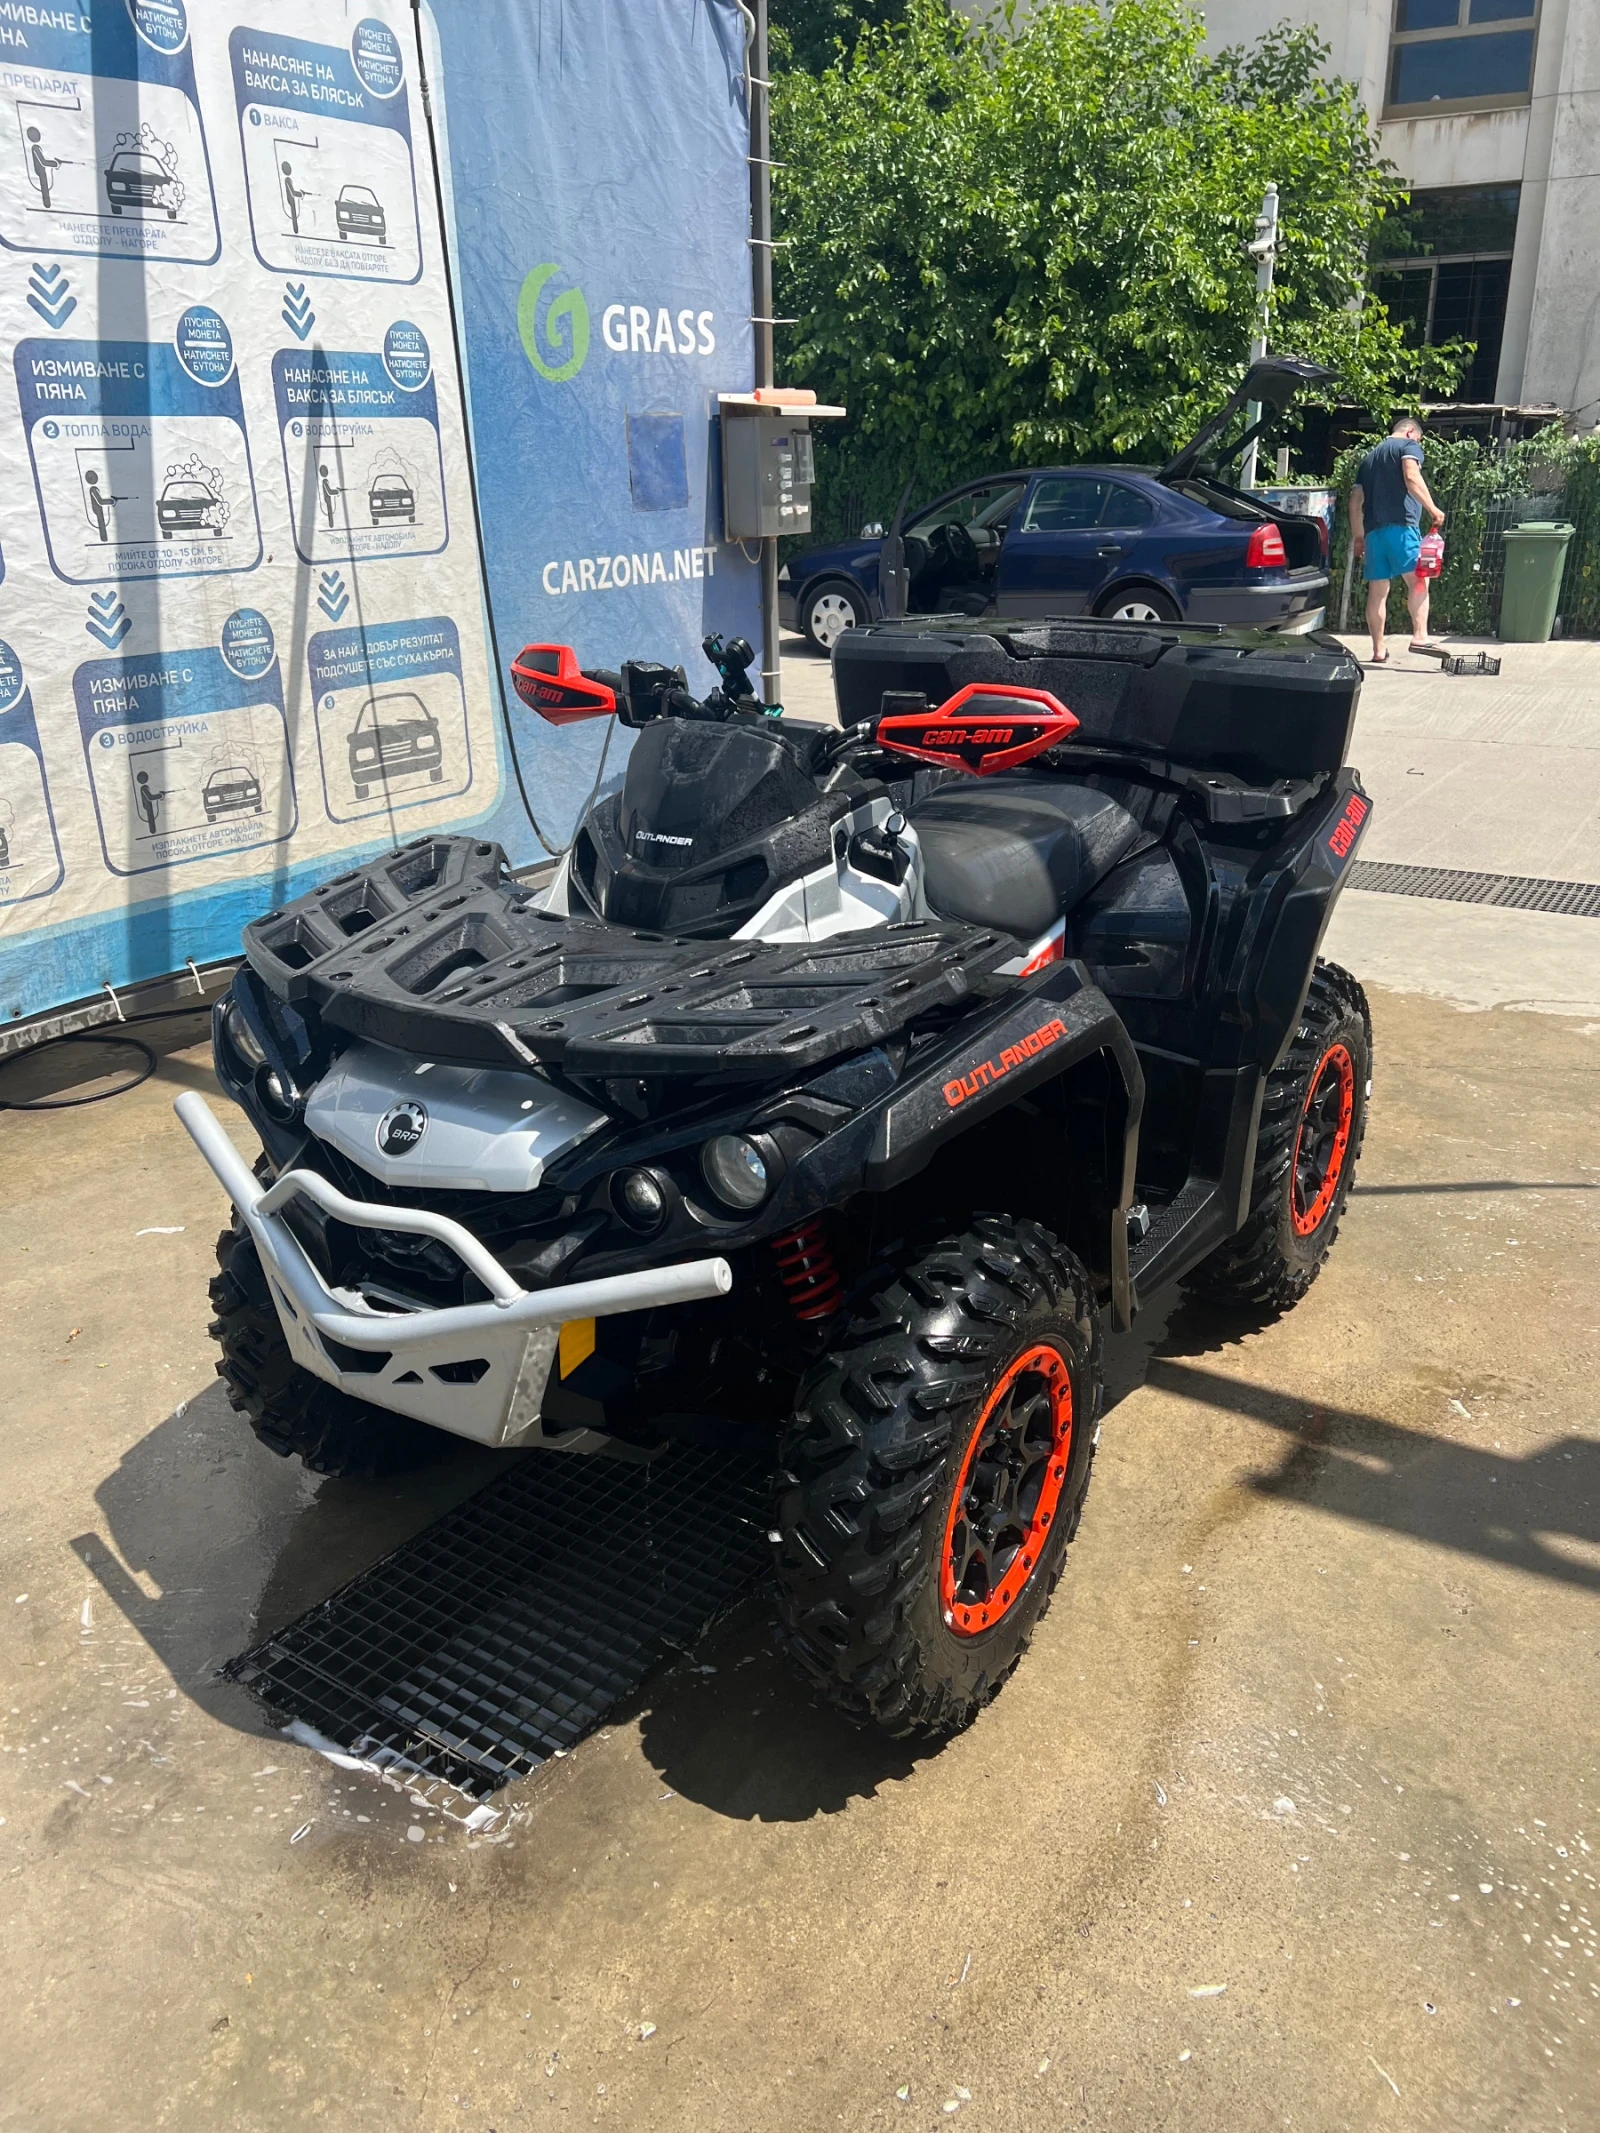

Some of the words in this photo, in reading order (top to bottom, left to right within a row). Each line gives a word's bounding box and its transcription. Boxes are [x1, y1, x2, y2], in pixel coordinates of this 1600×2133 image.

[136, 8, 184, 30] НАТИСНЕТЕ
[145, 23, 179, 40] БУТОНА
[358, 27, 392, 44] ПУСНЕТЕ
[361, 39, 392, 54] МОНЕТА
[242, 47, 313, 77] НАНАСЯНЕ
[316, 63, 335, 82] НА
[357, 58, 400, 76] НАТИСНЕТЕ
[3, 72, 78, 95] ПРЕПАРАТ
[365, 71, 394, 85] БУТОНА
[245, 70, 290, 94] ВАКСА
[292, 79, 310, 98] ЗА
[311, 83, 364, 108] БЛЯСЪК
[263, 113, 300, 131] ВАКСА
[59, 222, 111, 236] НАНЕСЕТЕ
[112, 225, 168, 240] ПРЕПАРАТА
[121, 238, 158, 249] НАГОРЕ
[184, 317, 221, 329] ПУСНЕТЕ
[602, 304, 716, 356] GRASS
[188, 329, 222, 340] МОНЕТА
[390, 330, 420, 341] ПУСНЕТЕ
[392, 340, 420, 350] МОНЕТА
[183, 350, 230, 361] НАТИСНЕТЕ
[388, 359, 428, 369] НАТИСНЕТЕ
[31, 359, 131, 378] ИЗМИВАНЕ
[133, 362, 145, 379] С
[193, 361, 226, 372] БУТОНА
[395, 369, 423, 379] БУТОНА
[284, 368, 351, 384] НАНАСЯНЕ
[352, 369, 370, 385] НА
[35, 382, 87, 400] ПЯНА
[286, 388, 328, 403] ВАКСА
[328, 389, 346, 404] ЗА
[347, 389, 396, 404] БЛЯСЪК
[62, 424, 110, 437] ТОПЛА
[305, 422, 374, 437] ВОДОСТРУЙКА
[115, 549, 147, 560] МИЙТЕ
[148, 550, 160, 559] ОТ
[161, 549, 172, 558] 10
[179, 548, 190, 557] 15
[108, 560, 145, 572] ПОСОКА
[147, 558, 183, 569] ОТДОЛУ
[189, 555, 223, 566] НАГОРЕ
[542, 547, 718, 596] CARZONA.NET
[229, 617, 263, 629] ПУСНЕТЕ
[232, 628, 263, 639] МОНЕТА
[228, 645, 272, 659] НАТИСНЕТЕ
[323, 649, 336, 660] ЗА
[338, 642, 359, 658] НАЙ
[366, 641, 399, 655] ДОБЪР
[400, 633, 444, 649] РЕЗУЛТАТ
[236, 656, 267, 668] БУТОНА
[376, 657, 396, 669] СЪС
[397, 653, 422, 666] СУХА
[423, 648, 455, 662] КЪРПА
[89, 670, 178, 695] ИЗМИВАНЕ
[182, 668, 193, 683] С
[518, 679, 564, 704] can-am
[93, 696, 140, 715] ПЯНА
[118, 720, 209, 745] ВОДОСТРУЙКА
[922, 728, 1014, 746] can-am
[1328, 794, 1368, 859] can-am
[152, 833, 207, 852] ИЗПЛАКНЕТЕ
[635, 830, 694, 846] OUTLANDER
[156, 847, 191, 860] ПОСОКА
[192, 839, 223, 852] ОТГОРЕ
[943, 1018, 1068, 1107] OUTLANDER
[391, 1128, 420, 1142] BRP
